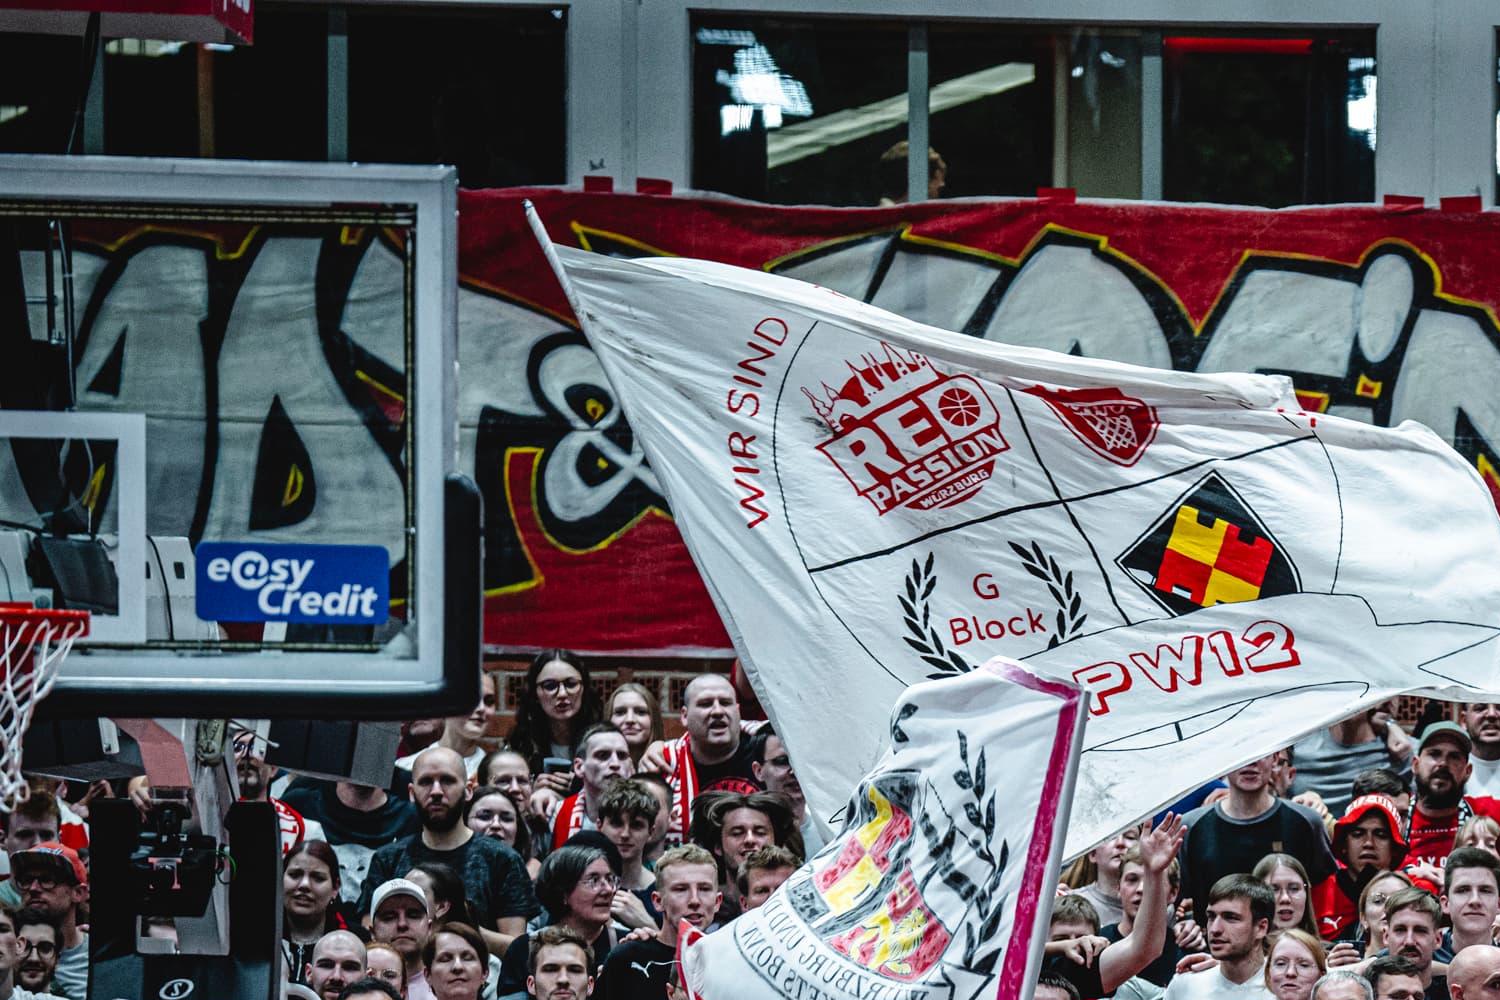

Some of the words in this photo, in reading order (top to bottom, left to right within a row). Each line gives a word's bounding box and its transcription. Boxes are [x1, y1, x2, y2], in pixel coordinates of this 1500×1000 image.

[726, 315, 790, 417] SIND
[822, 375, 998, 492] RED
[866, 427, 1006, 511] PASSION
[727, 429, 771, 530] WIR
[918, 469, 991, 508] WÜRZBURG
[257, 582, 379, 618] Credit
[950, 606, 1048, 646] Block
[972, 573, 1000, 600] G
[1070, 619, 1301, 720] PW12
